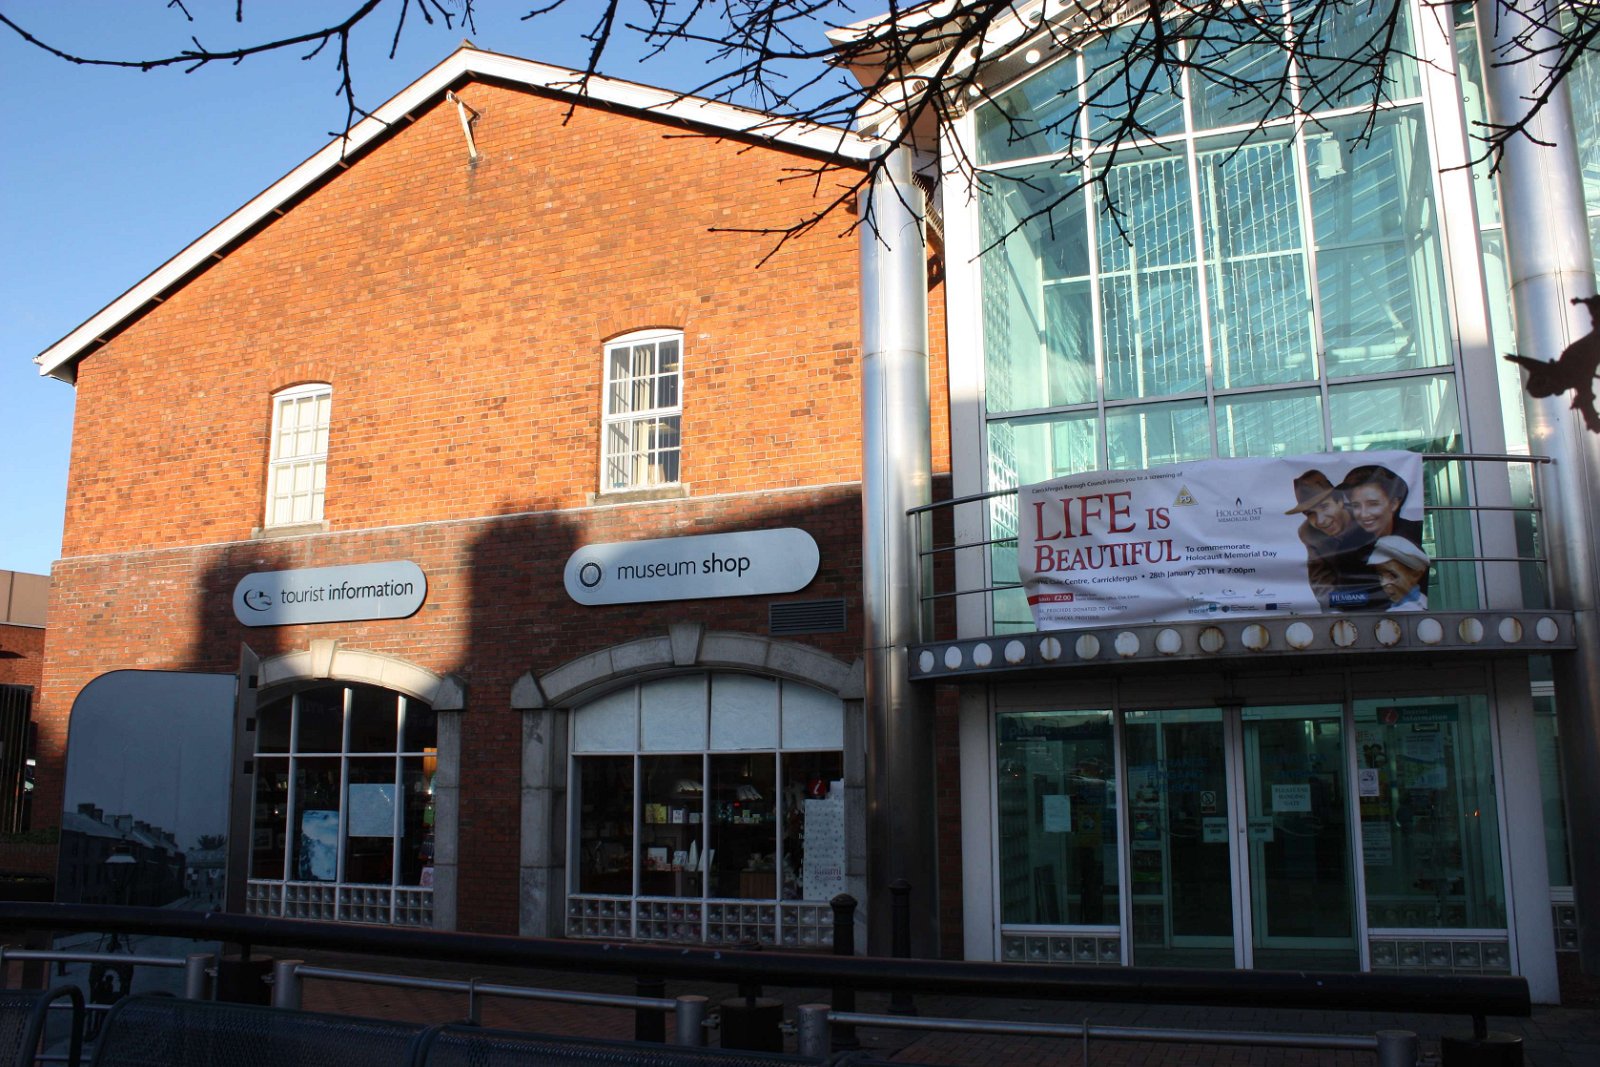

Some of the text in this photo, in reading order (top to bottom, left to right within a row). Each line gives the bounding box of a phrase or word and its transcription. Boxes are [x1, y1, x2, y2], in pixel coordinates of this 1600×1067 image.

[1064, 482, 1086, 491] Borough
[1087, 479, 1107, 487] Council
[1126, 477, 1136, 485] you
[1149, 473, 1176, 481] screening
[1032, 491, 1170, 542] LIFE IS
[1216, 507, 1262, 517] HOLOCAUST
[618, 552, 750, 580] museum shop
[1034, 540, 1182, 574] BEAUTIFUL
[1186, 550, 1277, 561] Holocaust Memorial Day
[1092, 575, 1138, 584] Carrickfergus
[1168, 569, 1195, 579] January
[1228, 567, 1256, 575] 7:00pm
[281, 579, 413, 604] tourist information
